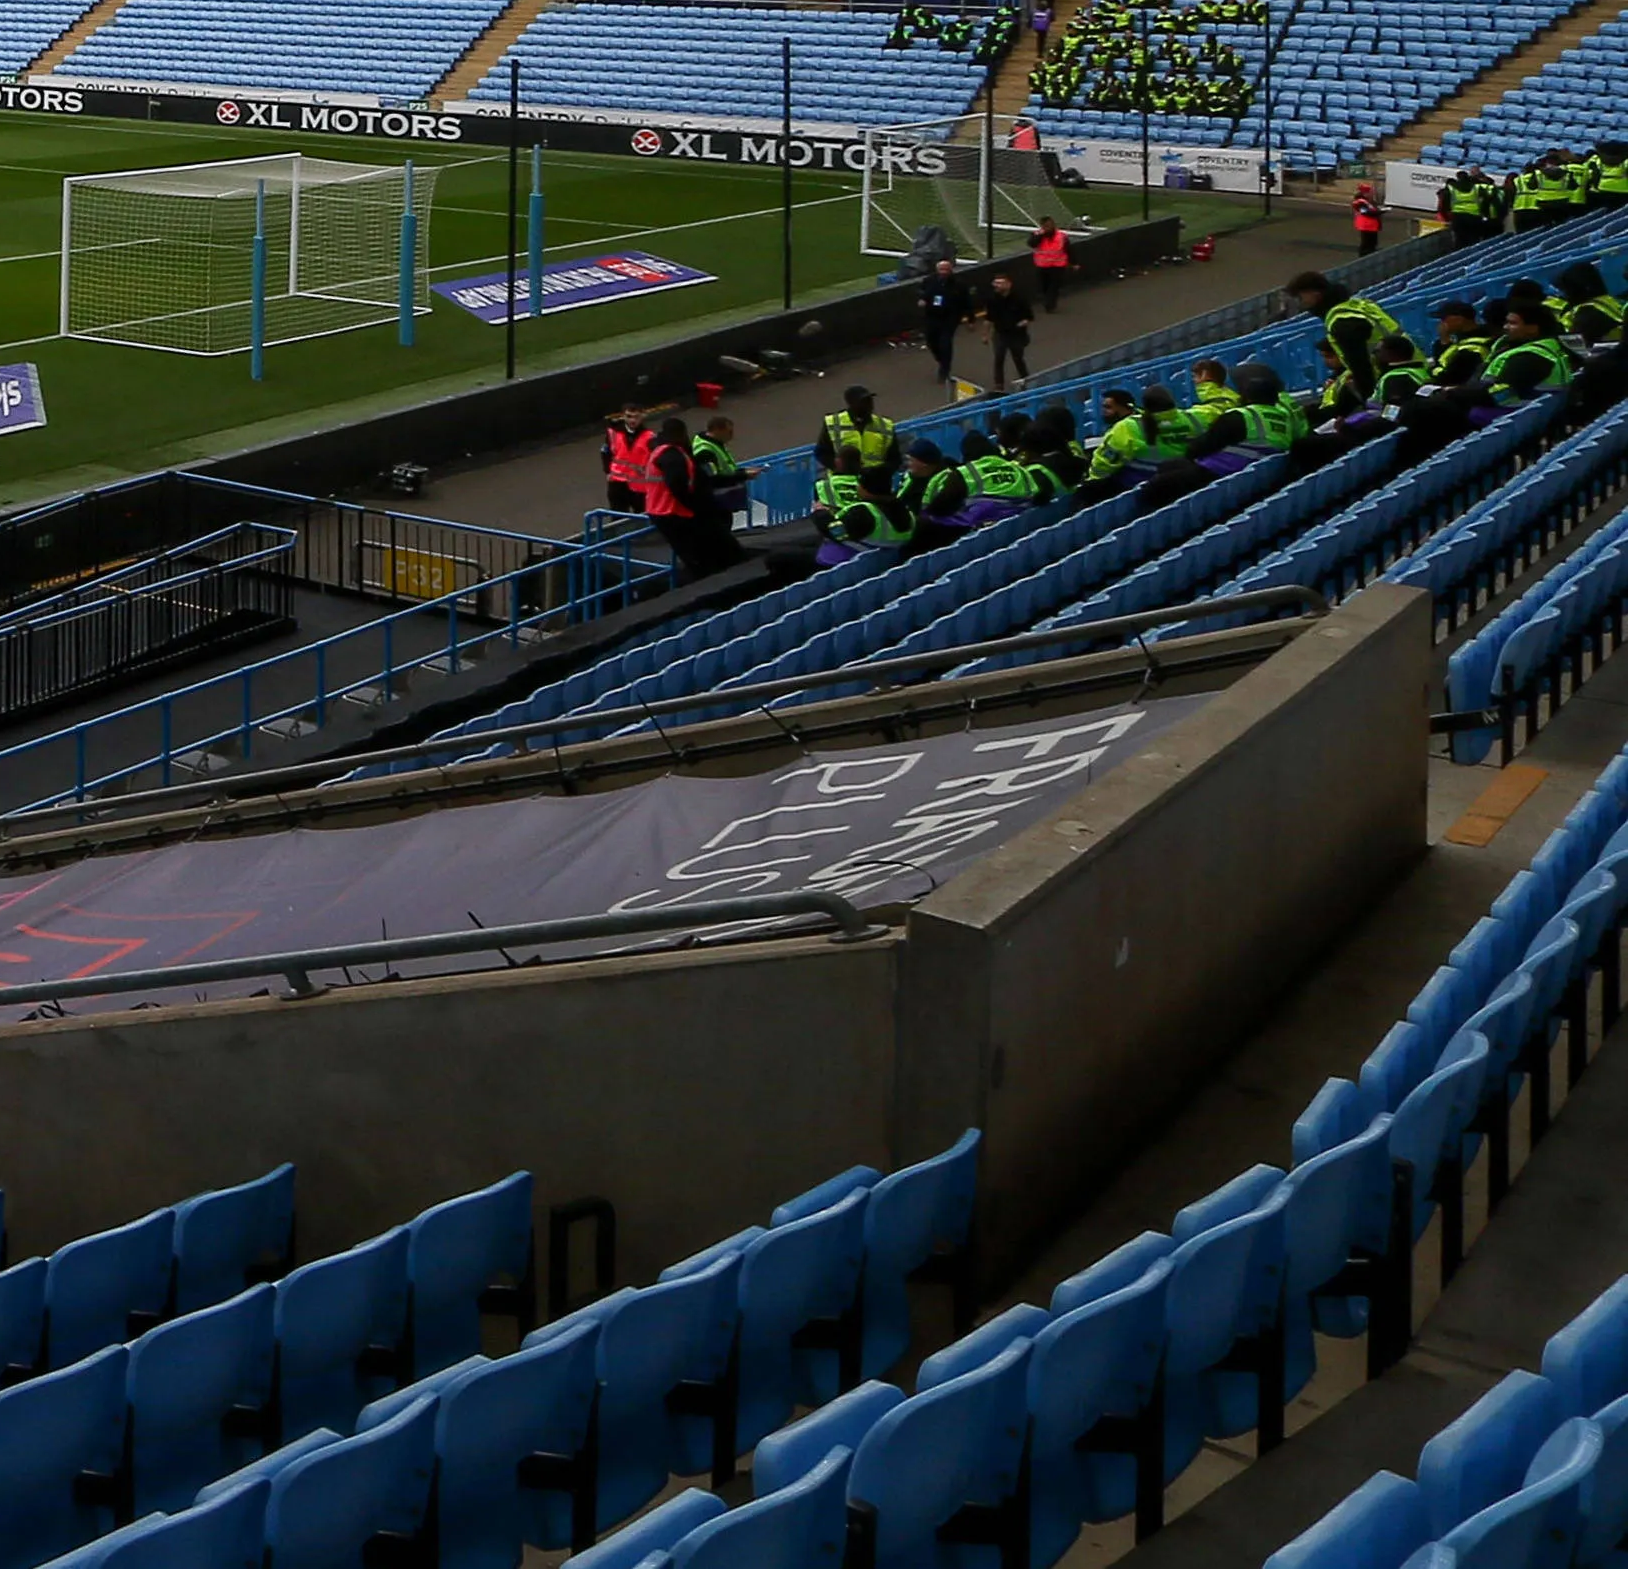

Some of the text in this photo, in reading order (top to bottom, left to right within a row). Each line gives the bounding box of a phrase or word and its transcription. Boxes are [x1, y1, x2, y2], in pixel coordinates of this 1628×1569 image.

[245, 102, 462, 141] XL MOTORS
[669, 131, 947, 175] XL MOTORS
[608, 752, 924, 915] PLUS
